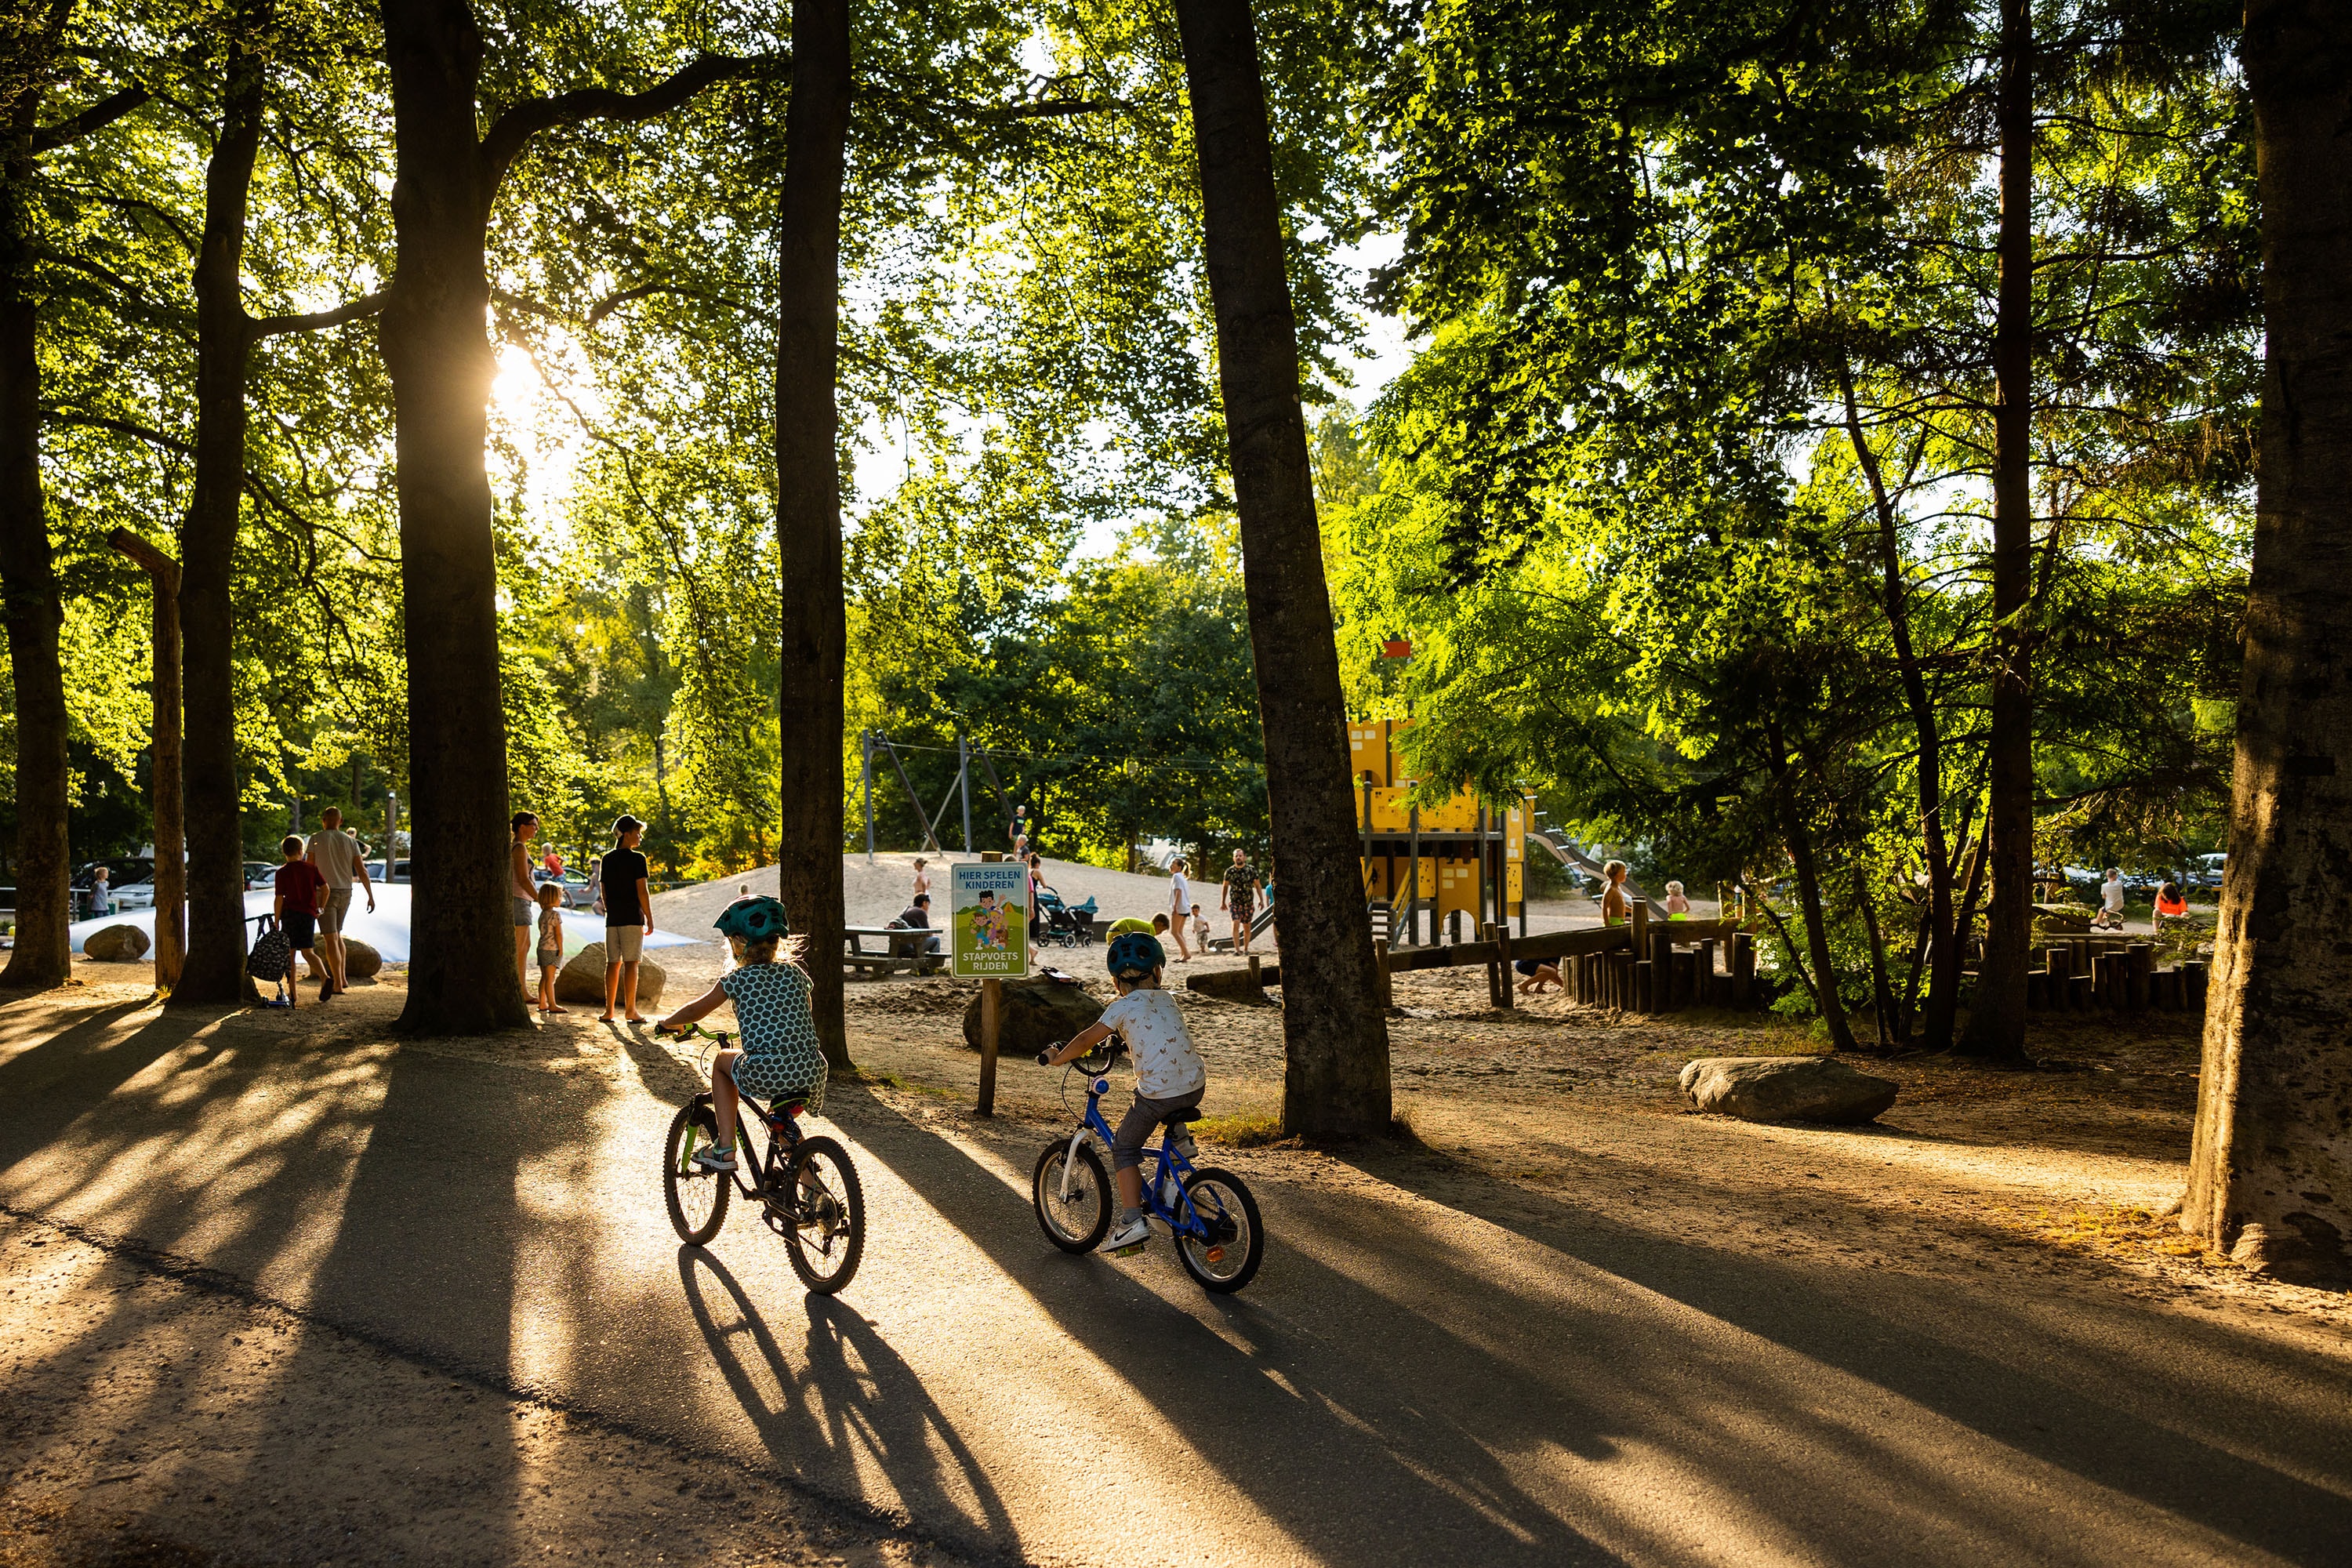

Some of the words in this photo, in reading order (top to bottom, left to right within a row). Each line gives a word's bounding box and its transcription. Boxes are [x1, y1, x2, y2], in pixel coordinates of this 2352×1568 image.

[959, 871, 982, 880] HIER
[984, 871, 1020, 880] SPELEN
[965, 880, 1014, 889] KINDEREN
[963, 952, 1018, 961] STAPVOETS
[973, 962, 1008, 971] RIJDEN
